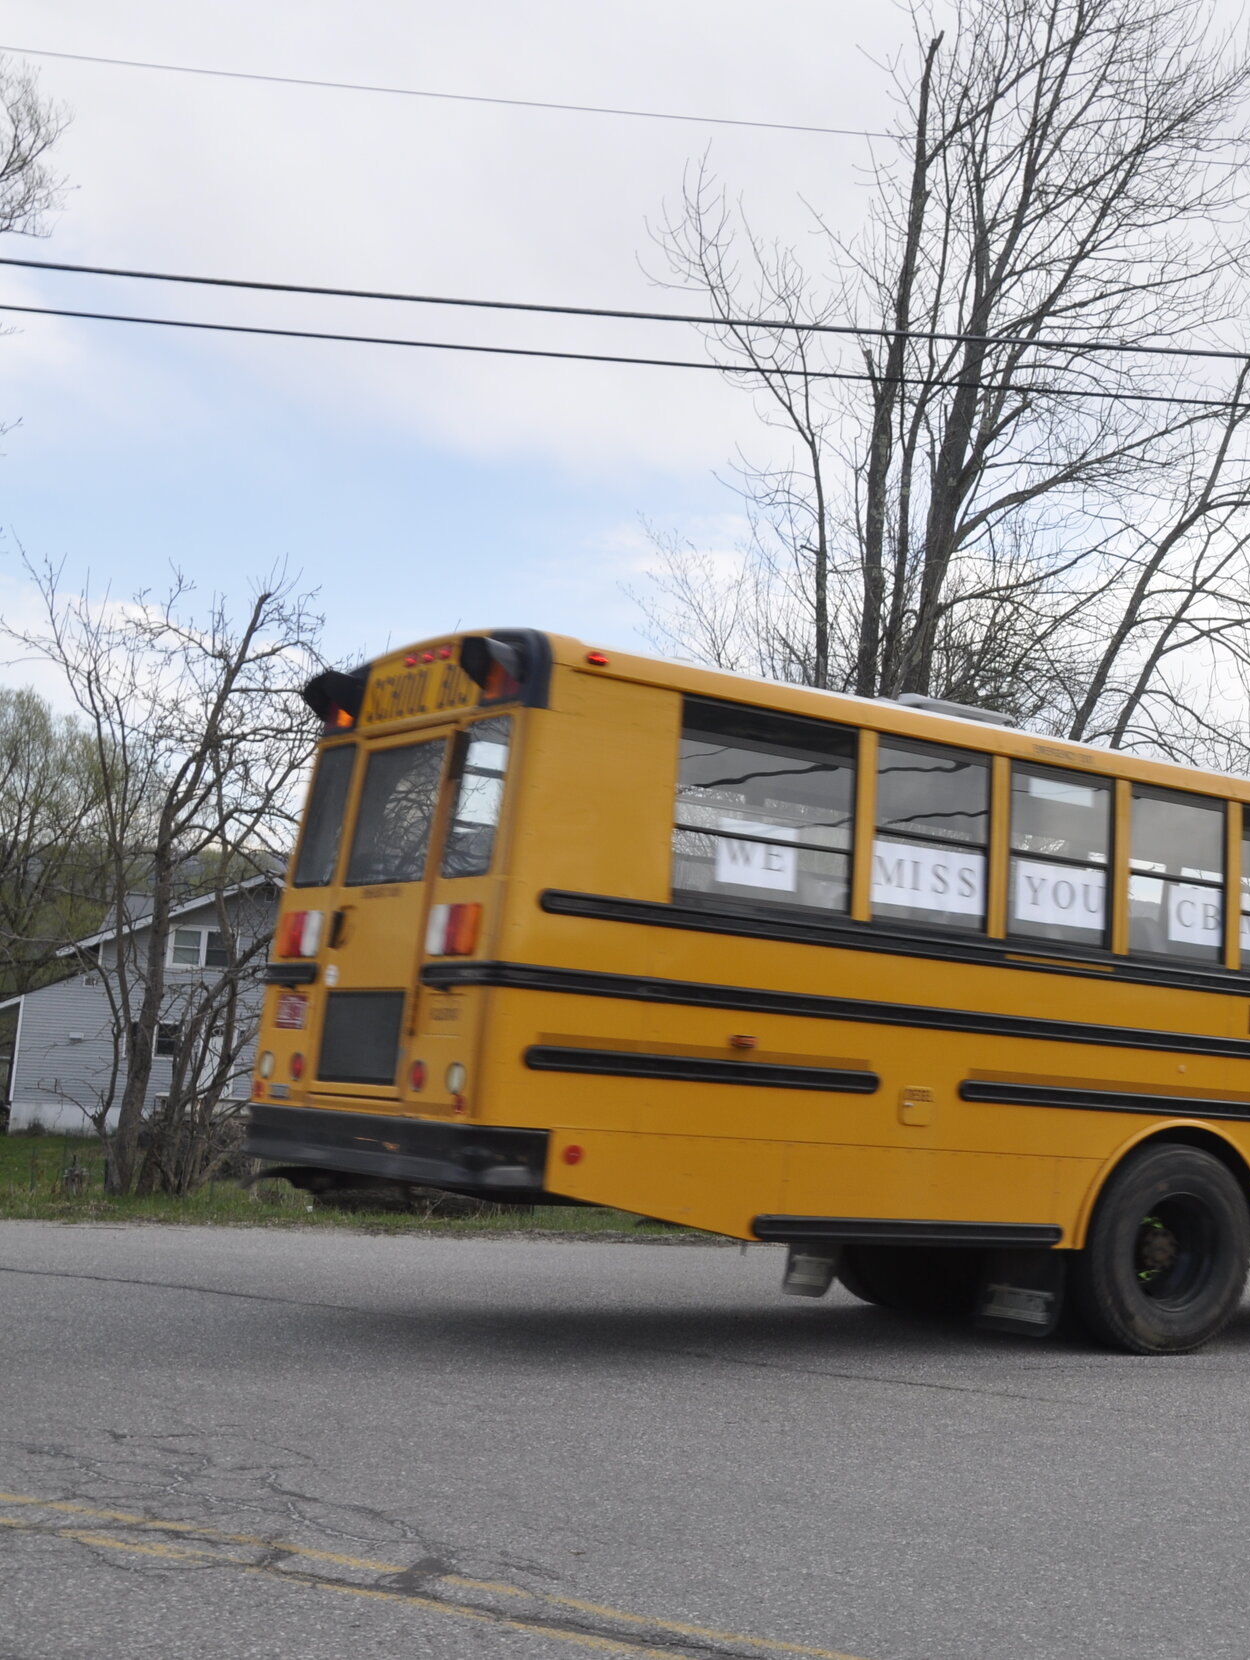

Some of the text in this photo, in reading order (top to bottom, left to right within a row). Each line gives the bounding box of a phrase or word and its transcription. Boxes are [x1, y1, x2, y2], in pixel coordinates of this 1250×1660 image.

[724, 838, 786, 873] WE
[872, 854, 978, 899] MISS
[1024, 874, 1105, 915] YOU
